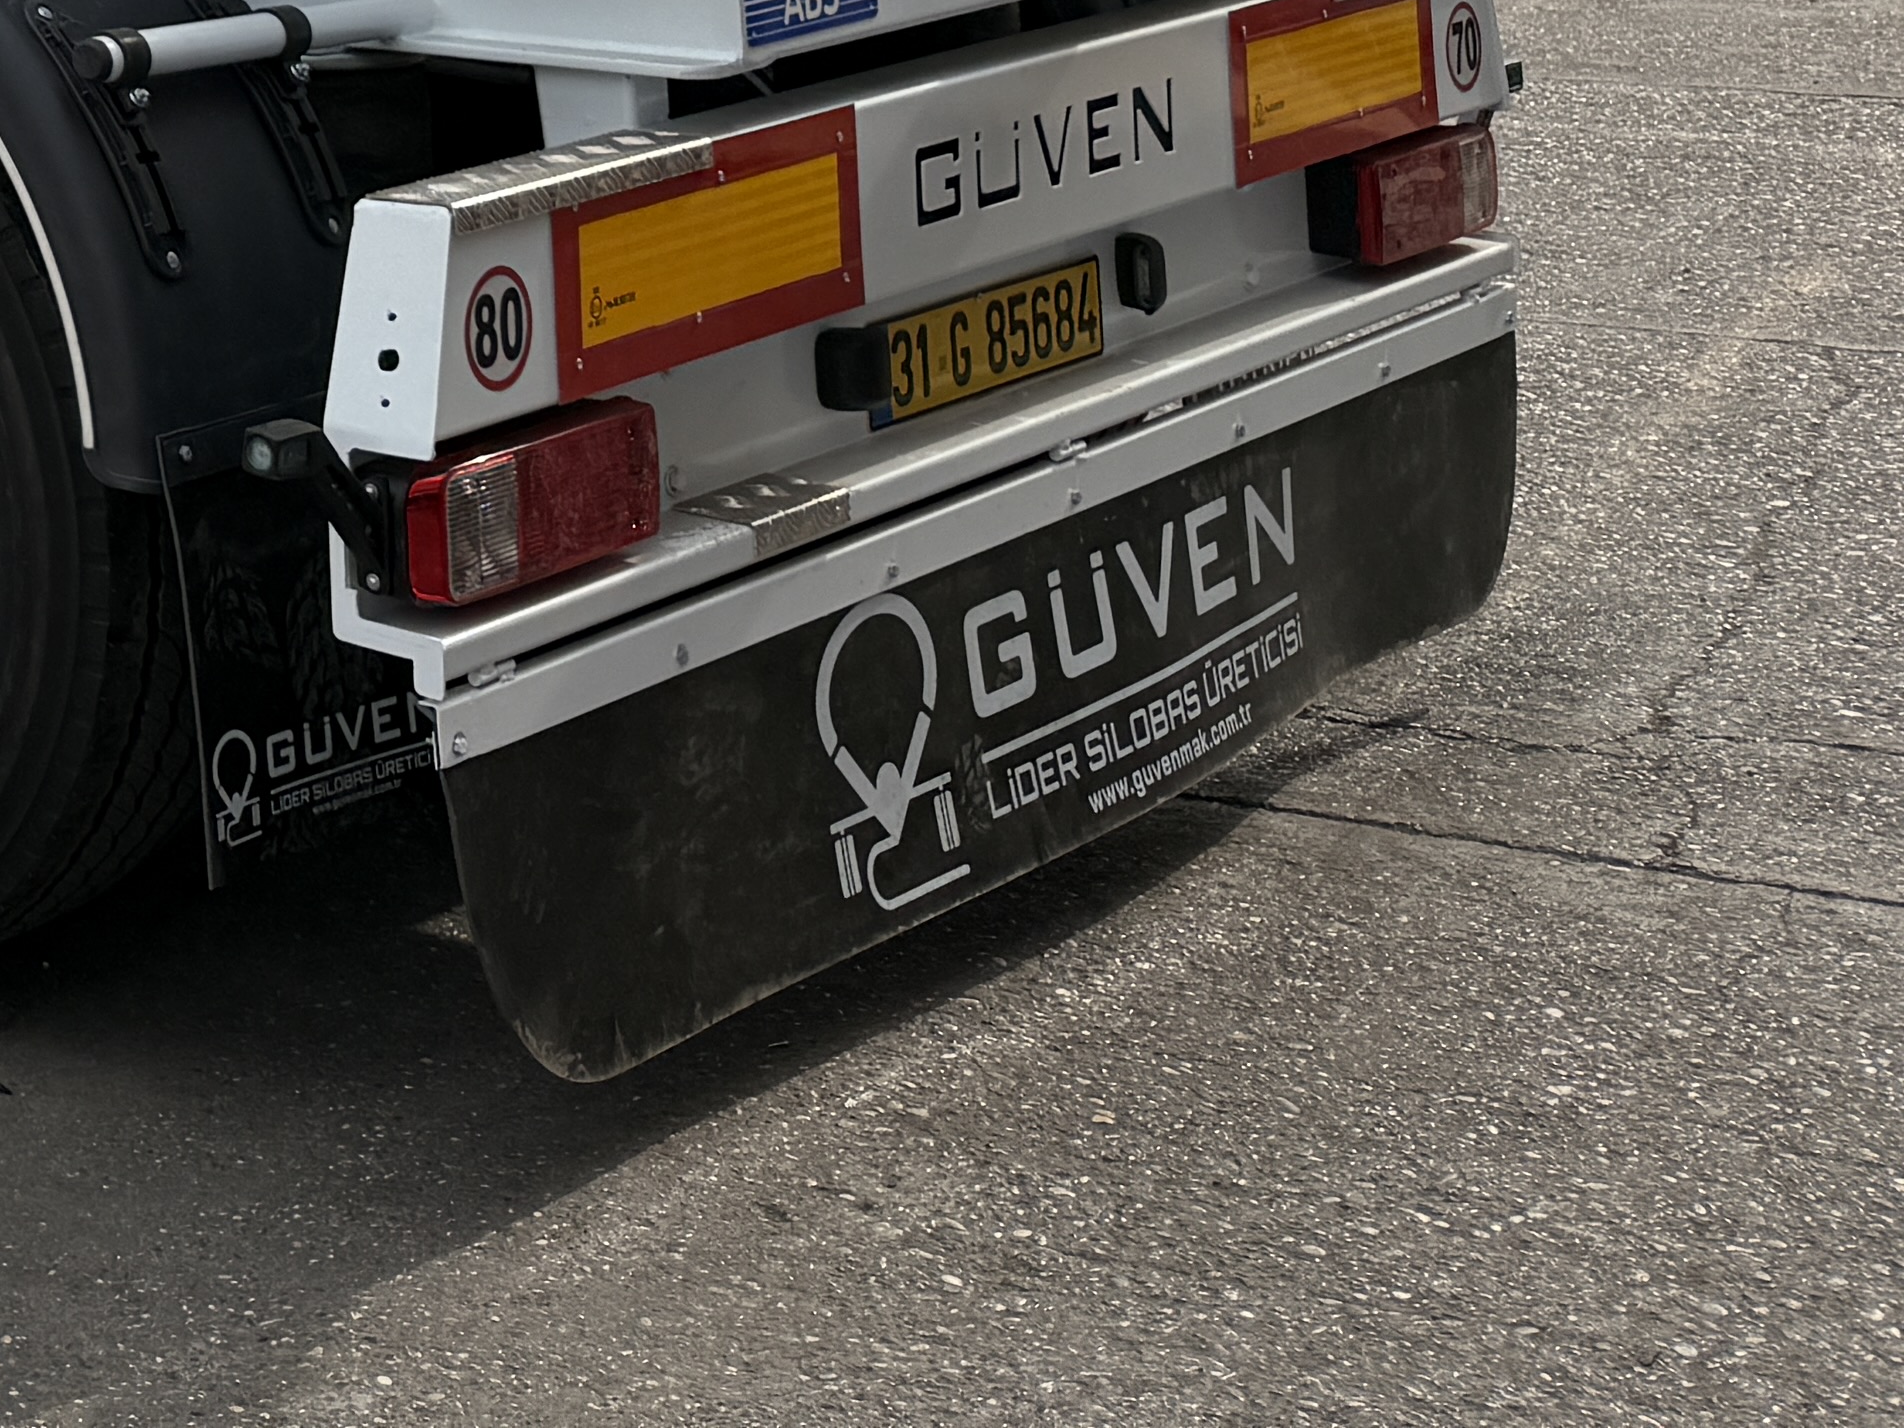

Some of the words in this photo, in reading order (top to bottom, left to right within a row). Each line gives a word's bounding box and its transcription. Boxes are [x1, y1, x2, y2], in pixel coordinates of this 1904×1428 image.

[1451, 16, 1477, 75] 70
[915, 77, 1174, 227] GÜVEN
[474, 286, 523, 369] 80
[891, 323, 930, 407] 31
[949, 310, 972, 387] G
[985, 271, 1098, 374] 85684
[963, 466, 1295, 719] GÜVEN
[986, 742, 1081, 820] LİDER
[1083, 679, 1202, 772] SİLOBAS
[1202, 612, 1304, 708] ÜRETİCİSİ
[1088, 701, 1253, 814] www.guvenmak.com.tr
